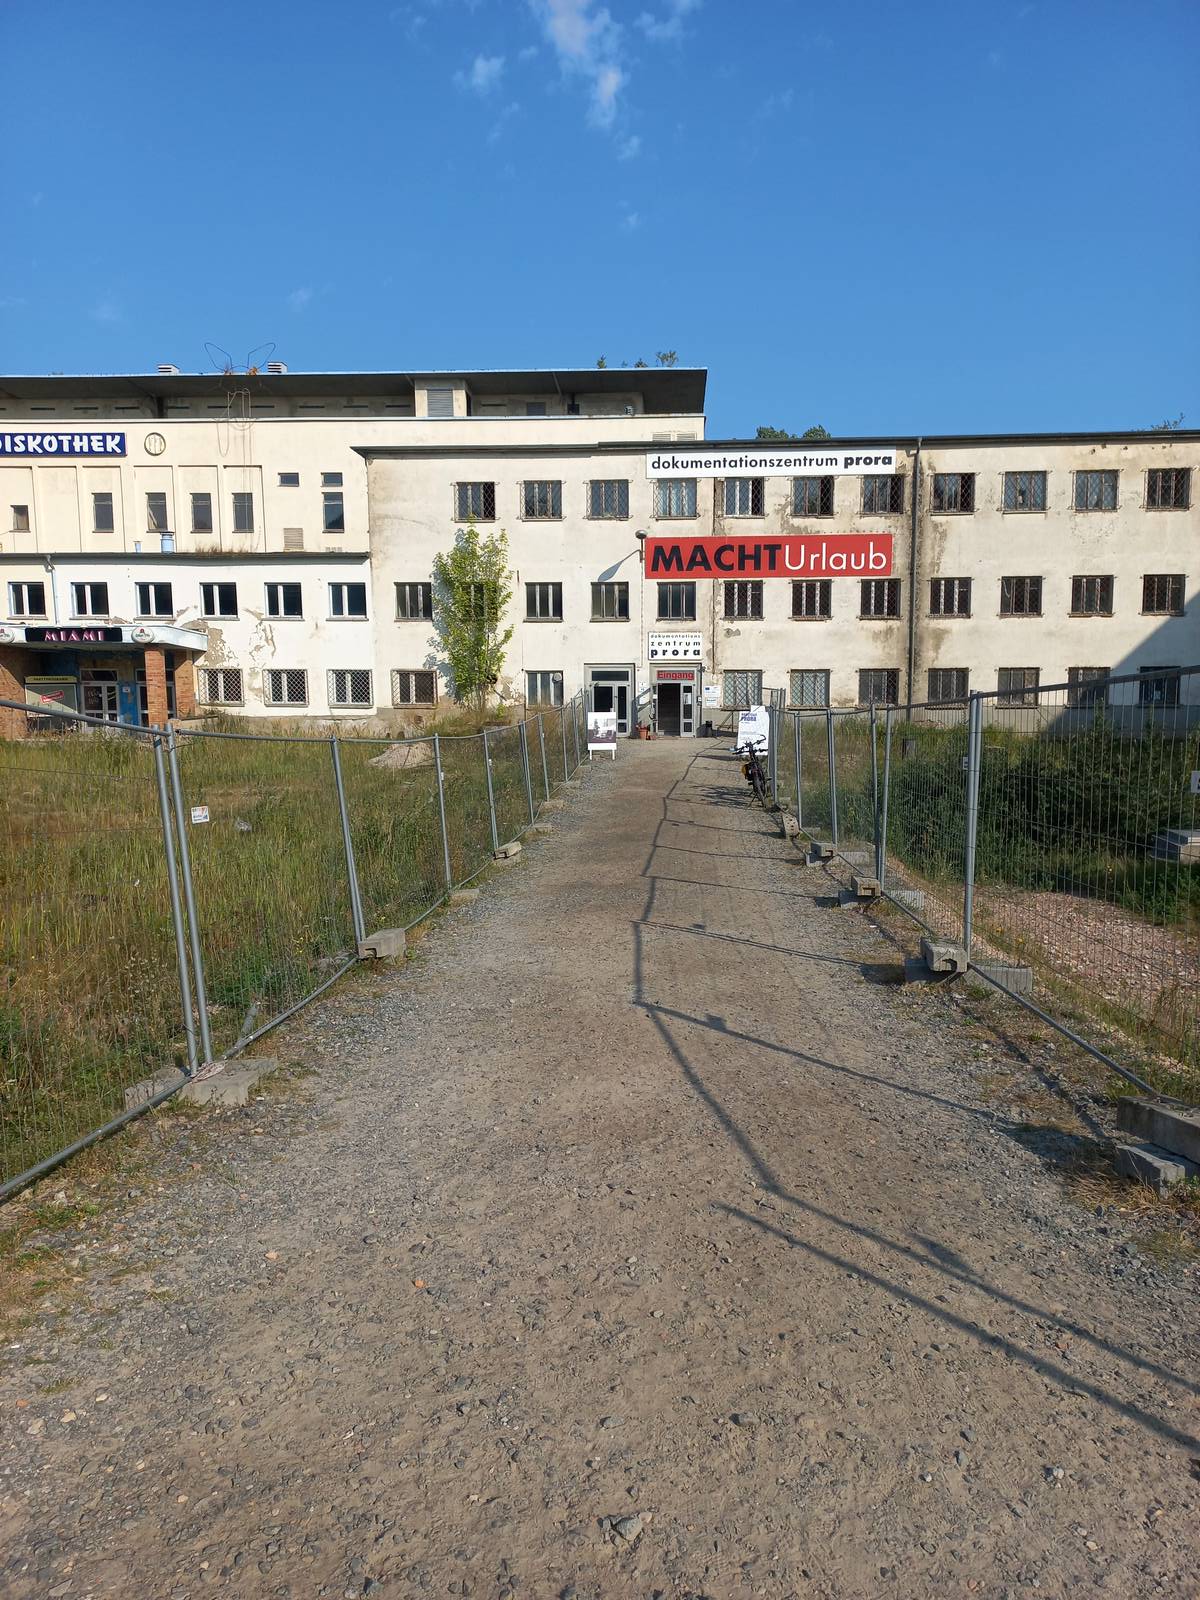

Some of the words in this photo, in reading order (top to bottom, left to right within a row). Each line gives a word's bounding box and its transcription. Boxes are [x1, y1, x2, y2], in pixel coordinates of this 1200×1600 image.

[651, 455, 838, 470] dokumentationszentrum
[844, 456, 893, 468] prora
[44, 630, 105, 642] MIAMI
[650, 649, 701, 658] prora
[657, 671, 694, 680] Eingang
